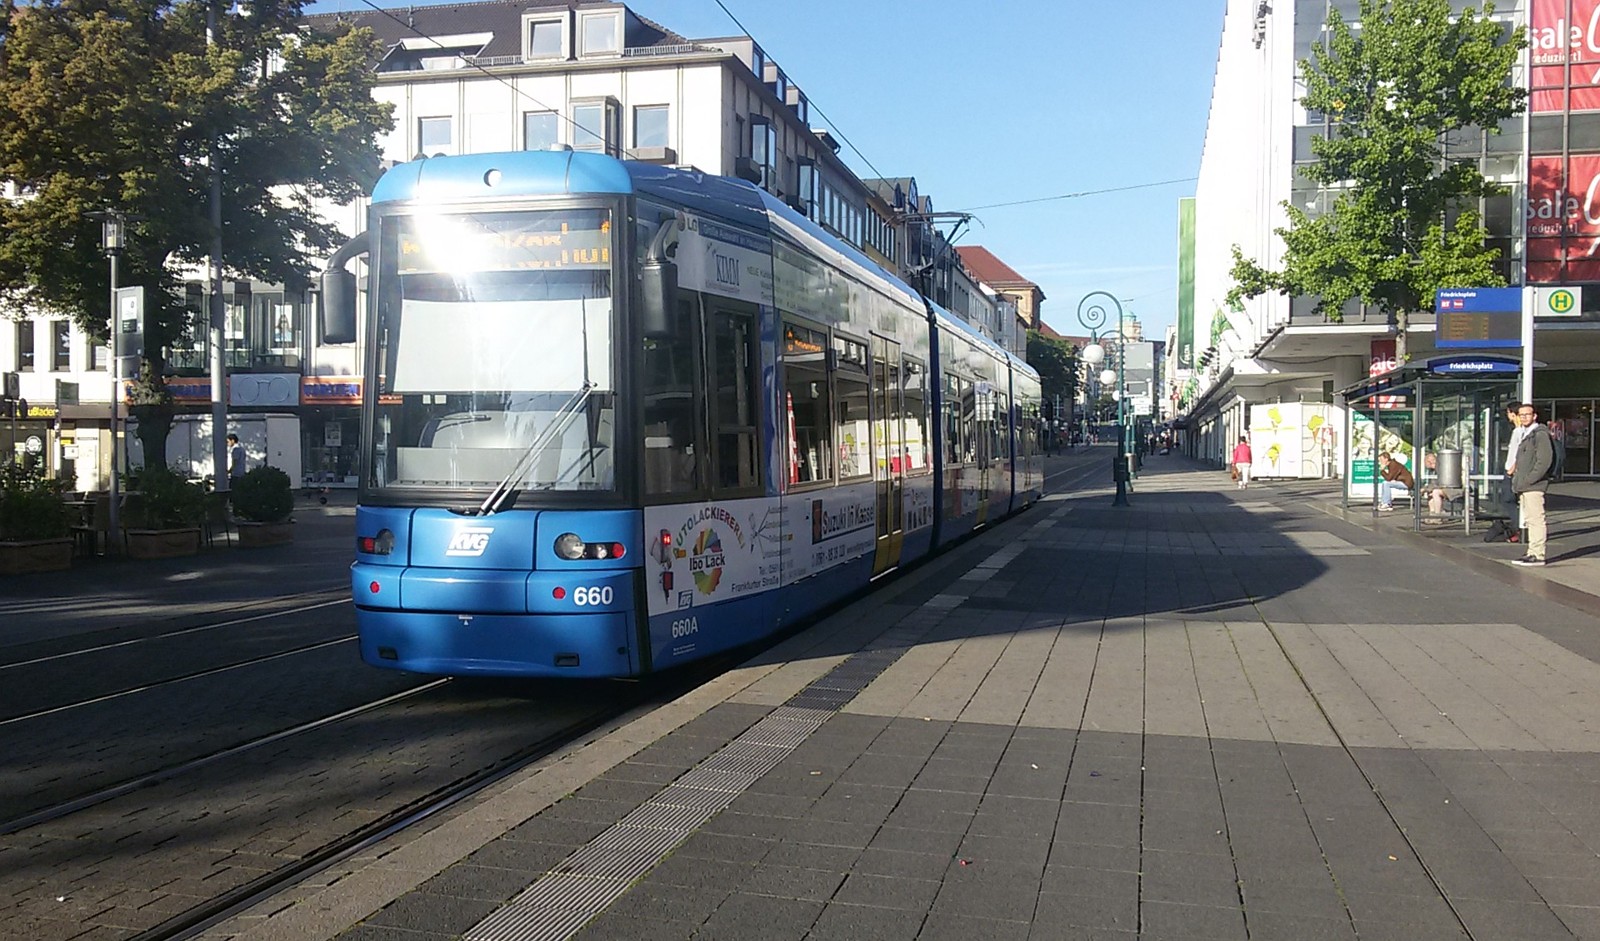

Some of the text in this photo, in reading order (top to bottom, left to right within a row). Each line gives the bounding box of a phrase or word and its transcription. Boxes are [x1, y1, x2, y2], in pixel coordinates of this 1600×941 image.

[1529, 18, 1582, 50] sale
[687, 218, 698, 232] LG
[1440, 291, 1477, 299] Friedrichsplatz
[1555, 295, 1568, 308] H
[1449, 361, 1493, 371] Friedrichsplatz
[447, 529, 493, 555] KVG
[690, 553, 726, 572] Ibo Lack
[573, 585, 613, 607] 660
[671, 616, 699, 639] 660A
